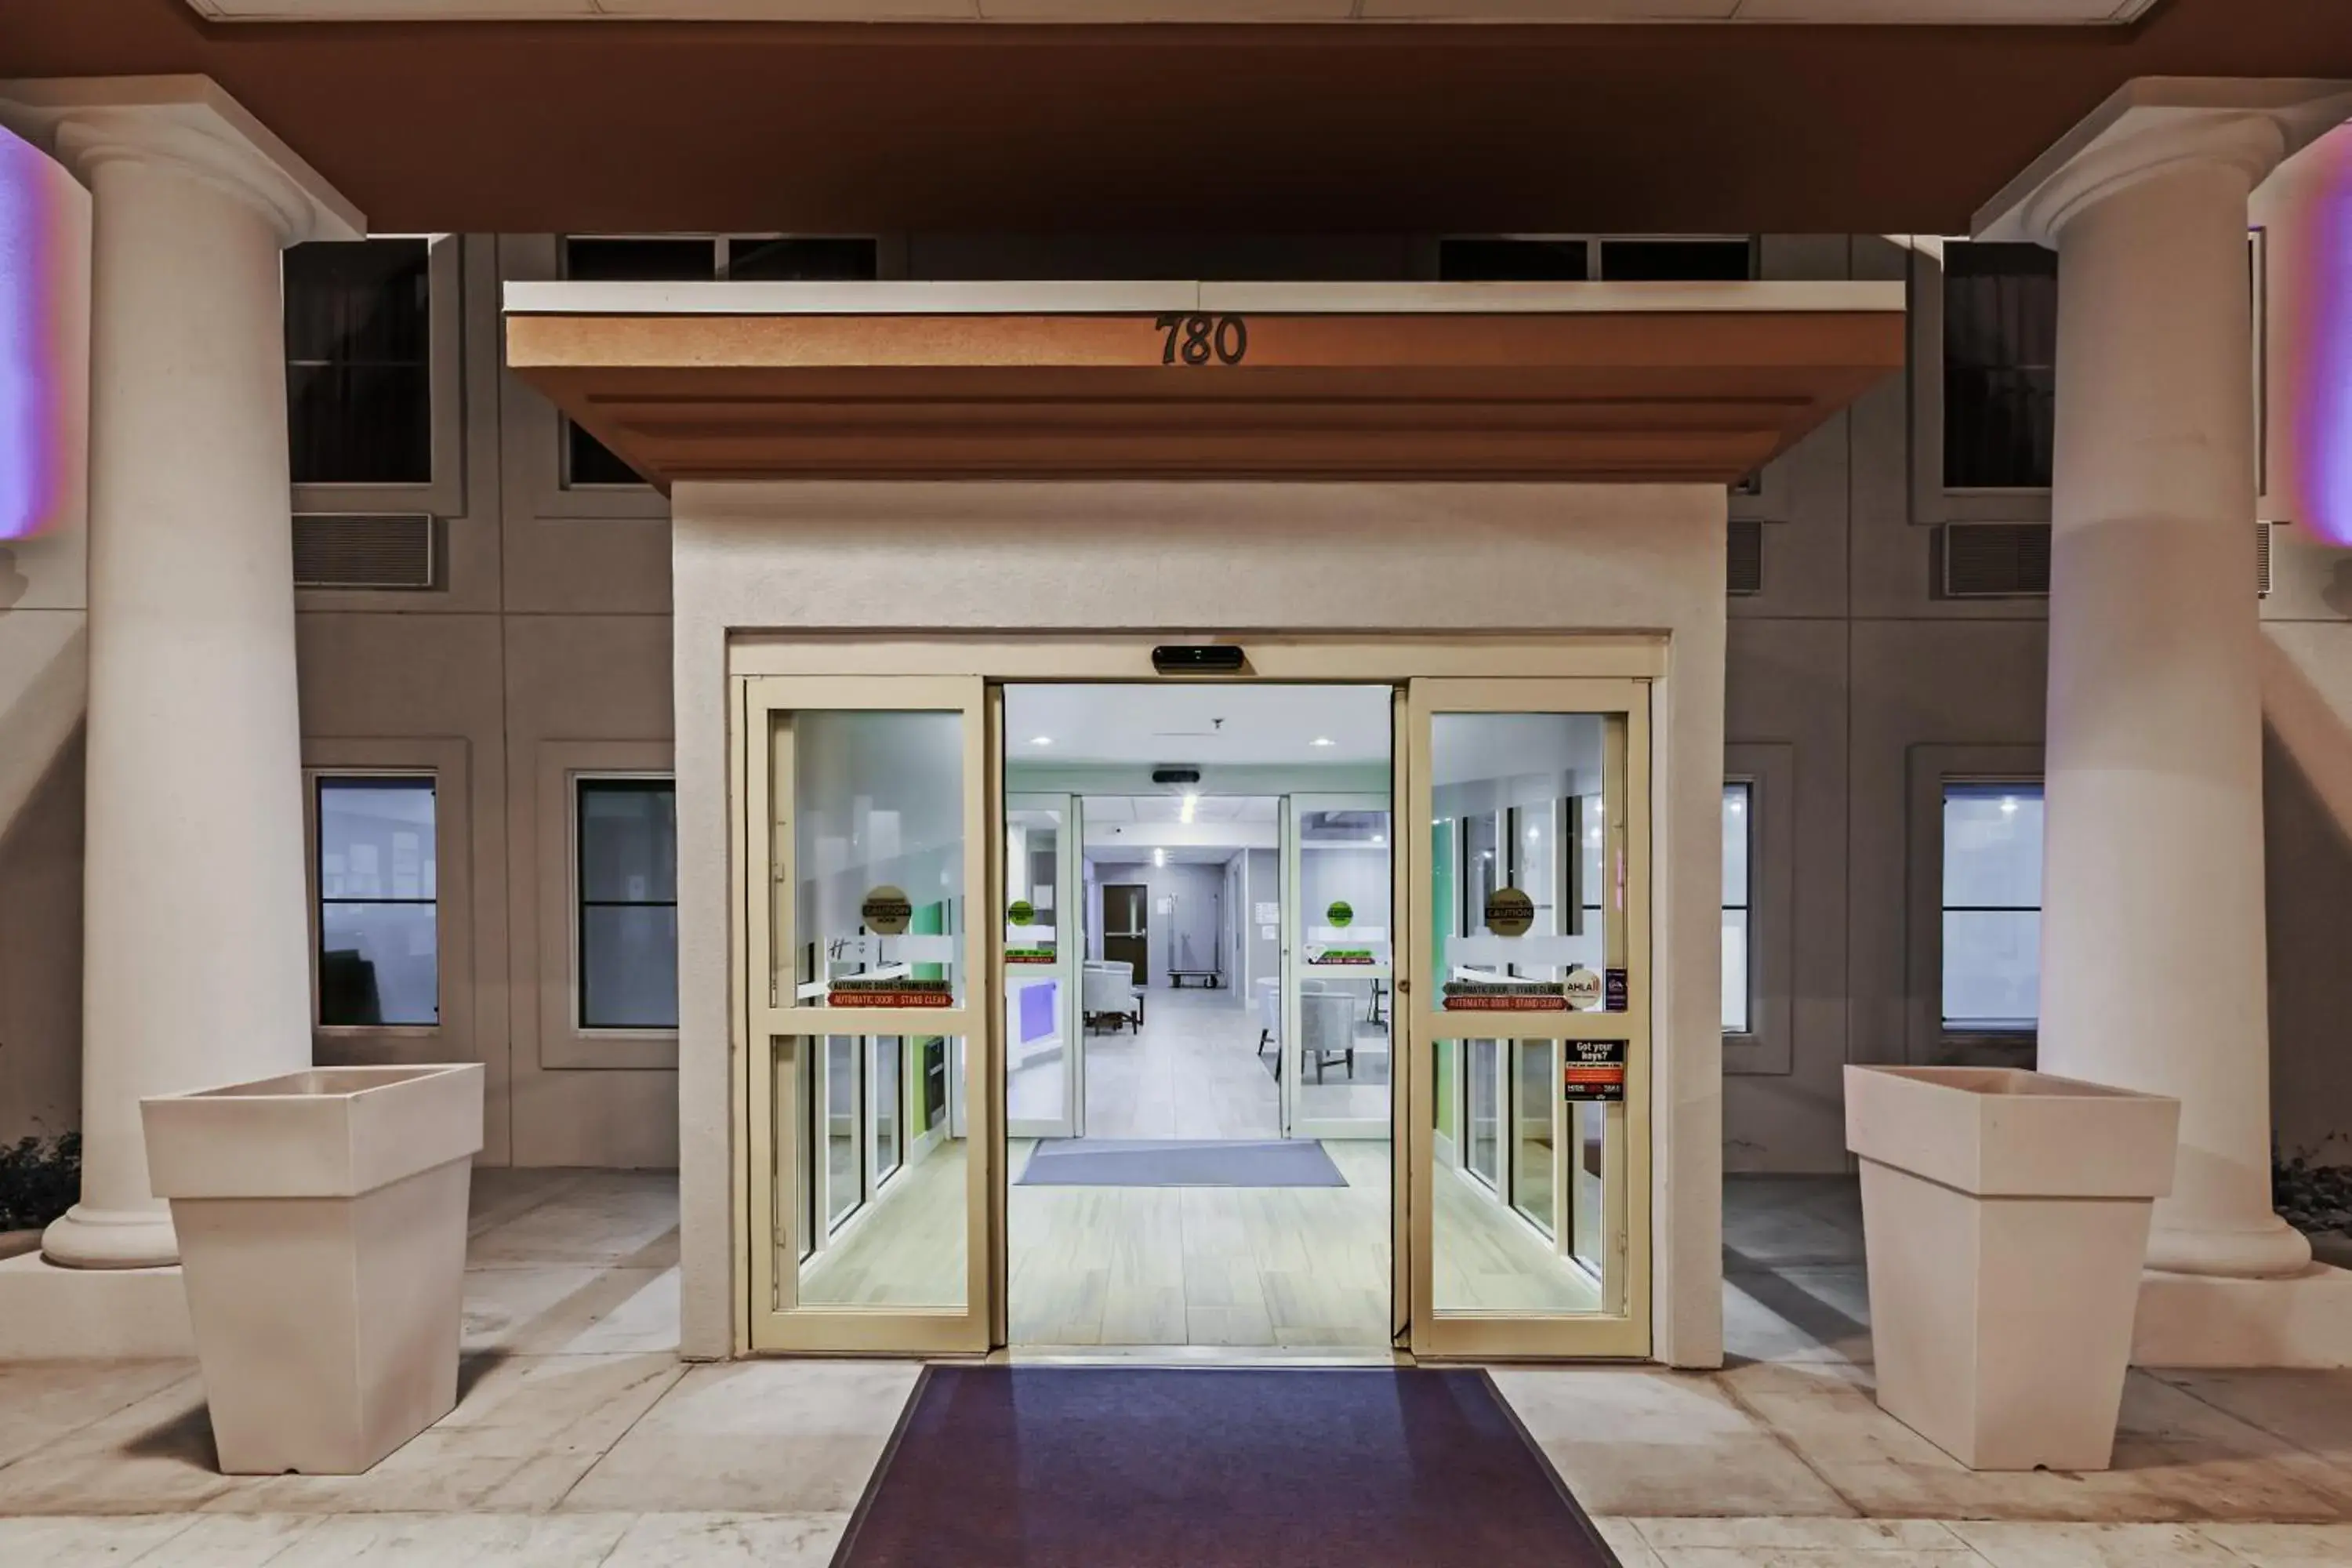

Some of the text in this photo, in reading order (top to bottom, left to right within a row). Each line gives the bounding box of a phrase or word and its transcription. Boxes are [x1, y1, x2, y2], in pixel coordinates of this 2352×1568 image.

[1155, 314, 1247, 365] 780
[834, 995, 946, 1004] AUTOMATIC DOOR STAND CLEAR
[1449, 999, 1489, 1008] AUTOMATIC
[1577, 1042, 1613, 1053] Got your
[1581, 1051, 1608, 1062] keys?
